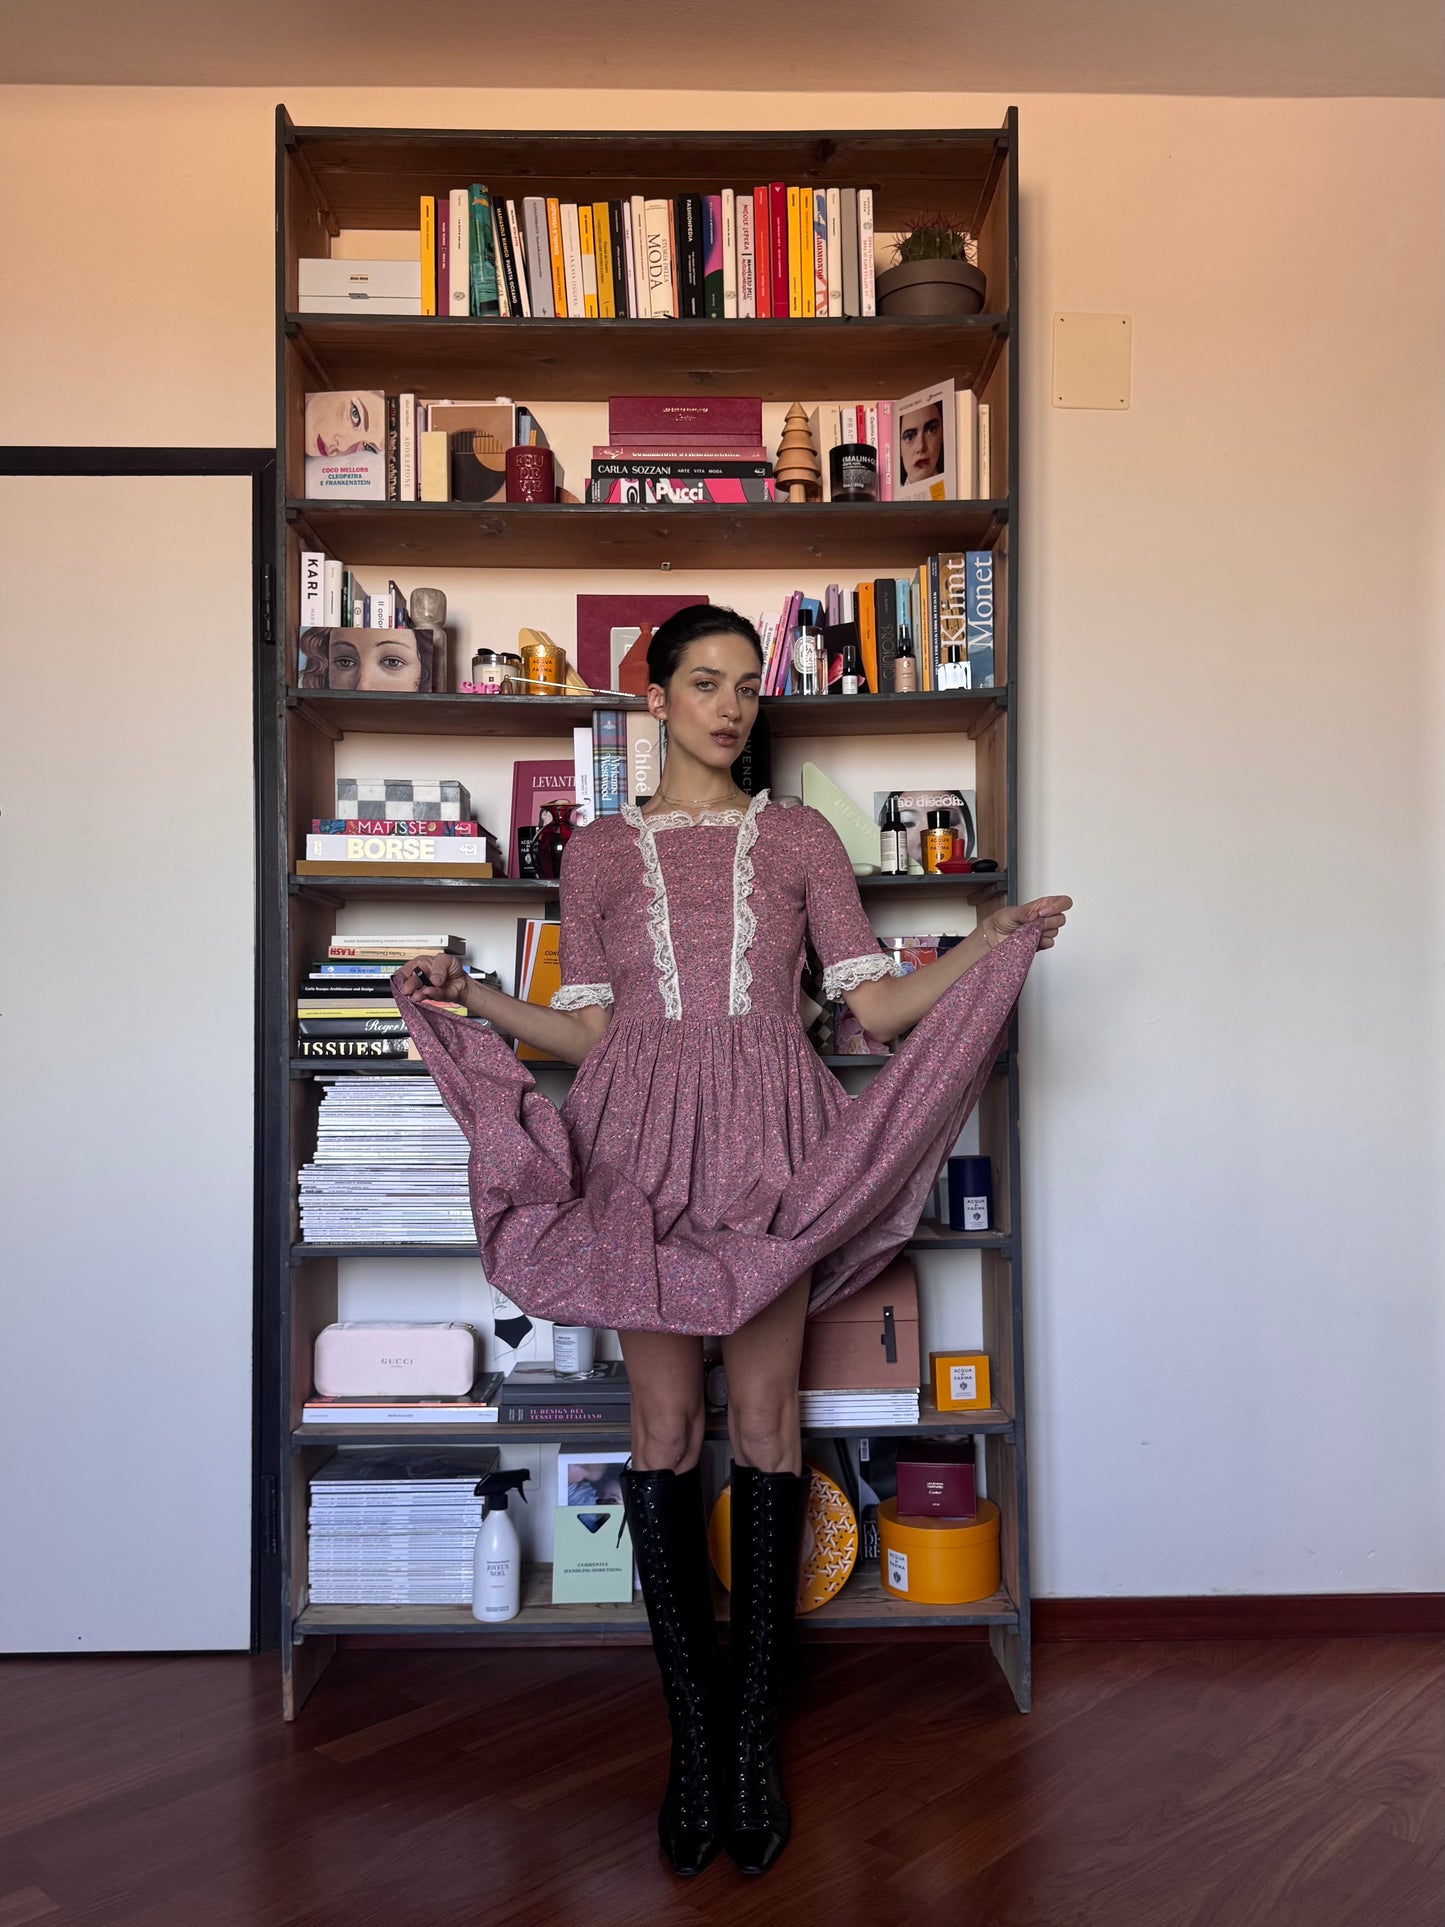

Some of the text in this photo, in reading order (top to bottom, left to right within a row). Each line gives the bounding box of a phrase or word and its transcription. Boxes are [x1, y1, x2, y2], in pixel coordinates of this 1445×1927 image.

[497, 208, 506, 237] MARIASOLE
[661, 238, 669, 261] STORIA
[506, 260, 514, 281] PIANETA
[647, 233, 664, 290] MODA
[509, 282, 518, 304] OCEANO
[520, 468, 540, 480] DE
[598, 466, 628, 474] CARLA
[632, 466, 670, 474] SOZZANI
[520, 480, 542, 492] VIE
[656, 482, 704, 500] Pucci
[308, 558, 318, 600] KARL
[940, 559, 966, 648] Klimt
[967, 556, 993, 649] Monet
[611, 756, 620, 795] Vivienne
[634, 738, 652, 792] Chloé
[601, 753, 612, 801] Westwood
[358, 821, 428, 834] MATISSE
[348, 838, 435, 860] BORSE
[330, 948, 356, 956] FLASH
[365, 1019, 400, 1034] Roger
[302, 1042, 382, 1056] ISSUES
